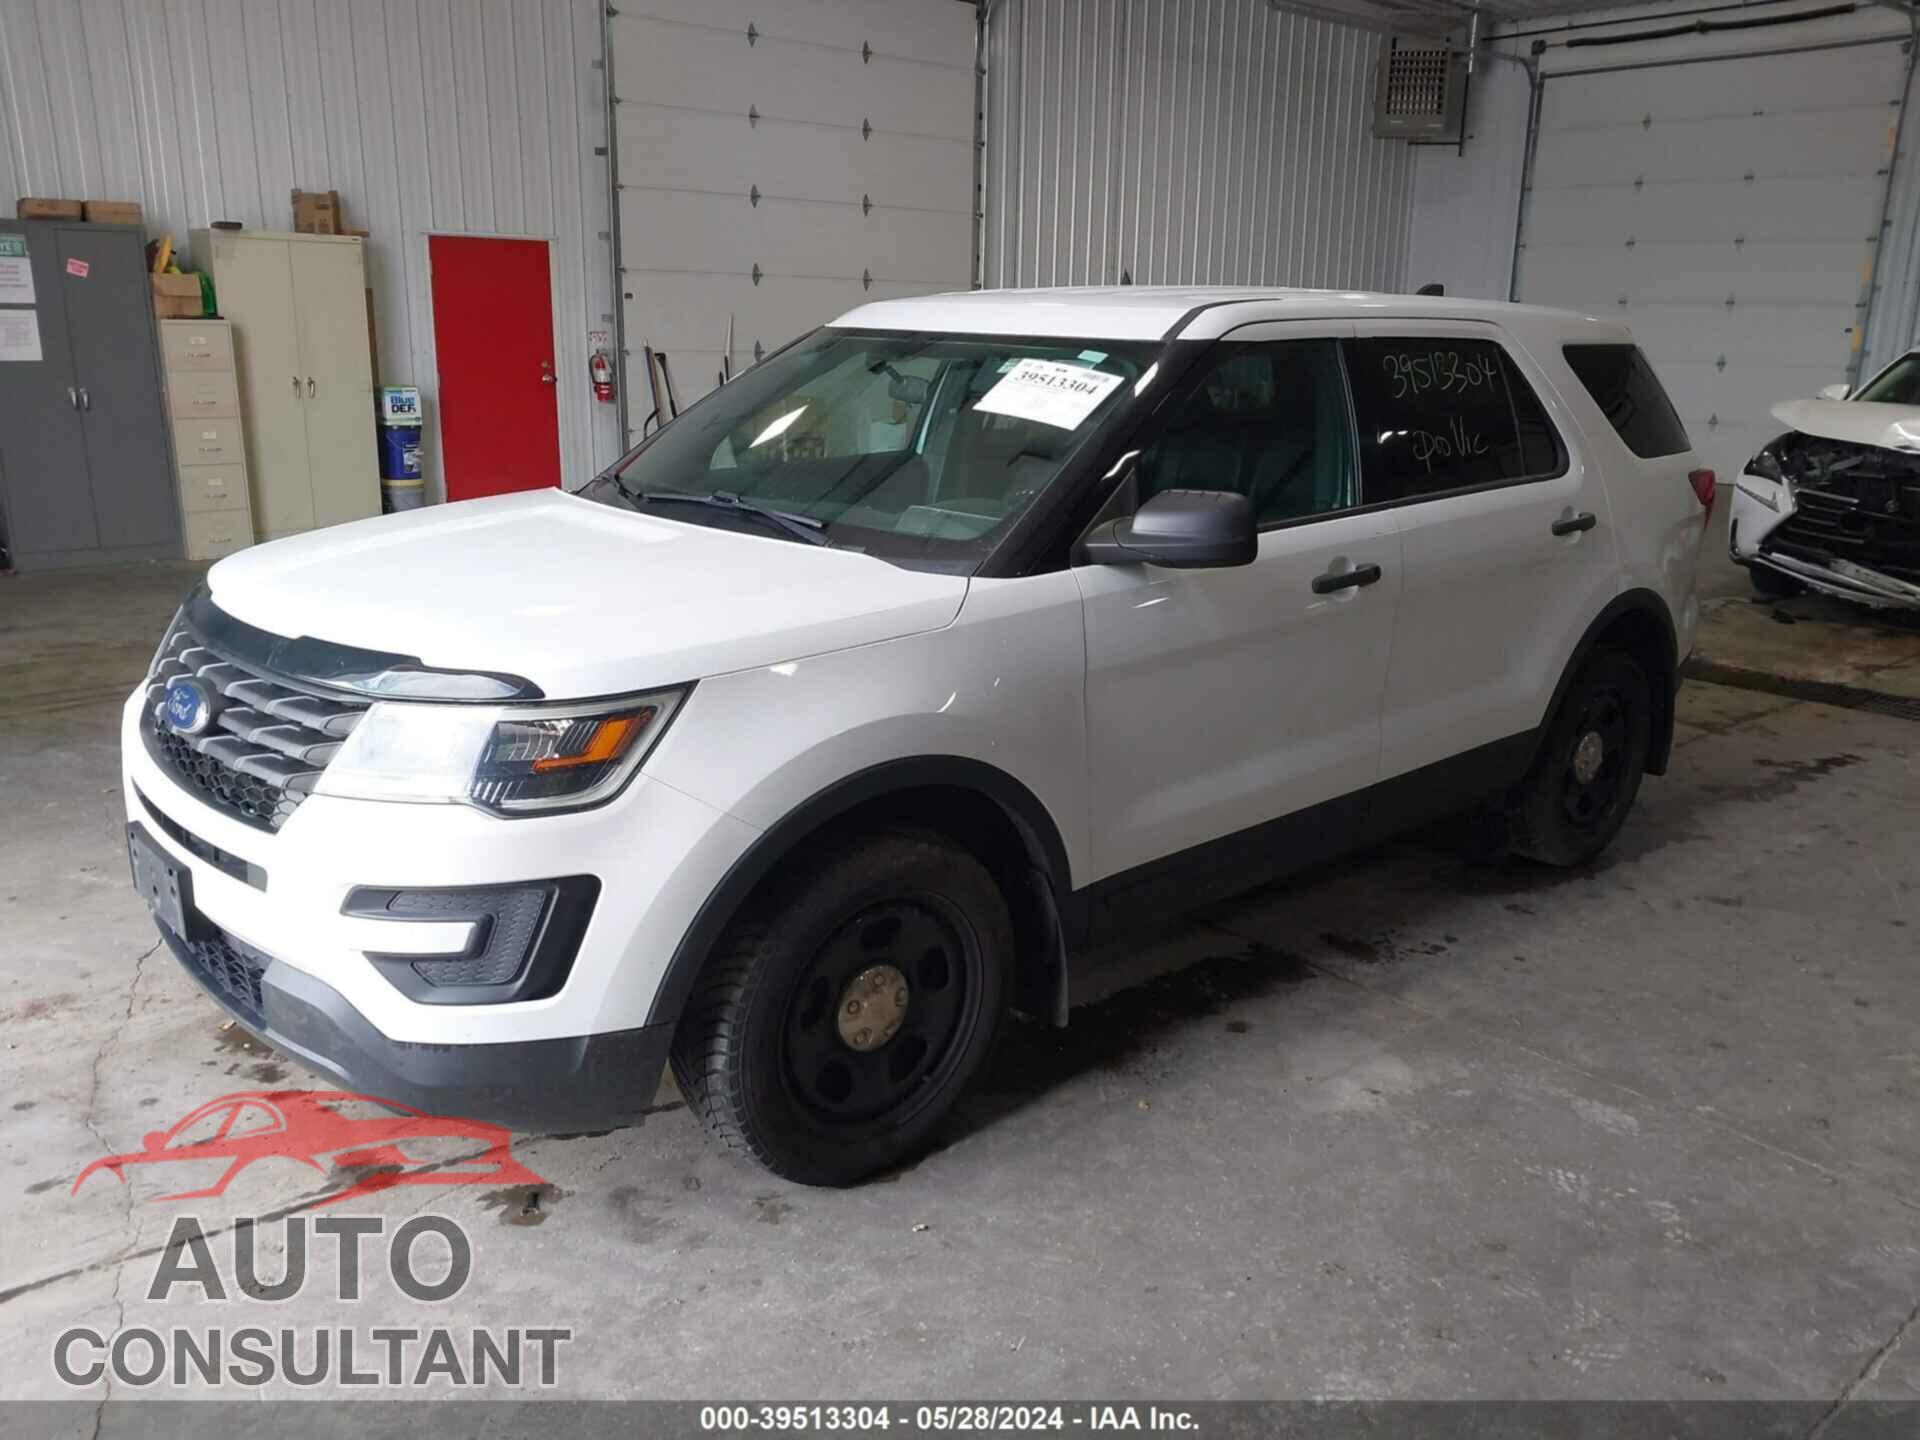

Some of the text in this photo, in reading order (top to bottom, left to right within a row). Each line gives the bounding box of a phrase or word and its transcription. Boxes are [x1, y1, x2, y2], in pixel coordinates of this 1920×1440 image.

[1015, 370, 1099, 395] 39513304
[1383, 351, 1497, 398] 39513304
[168, 687, 192, 720] Ford
